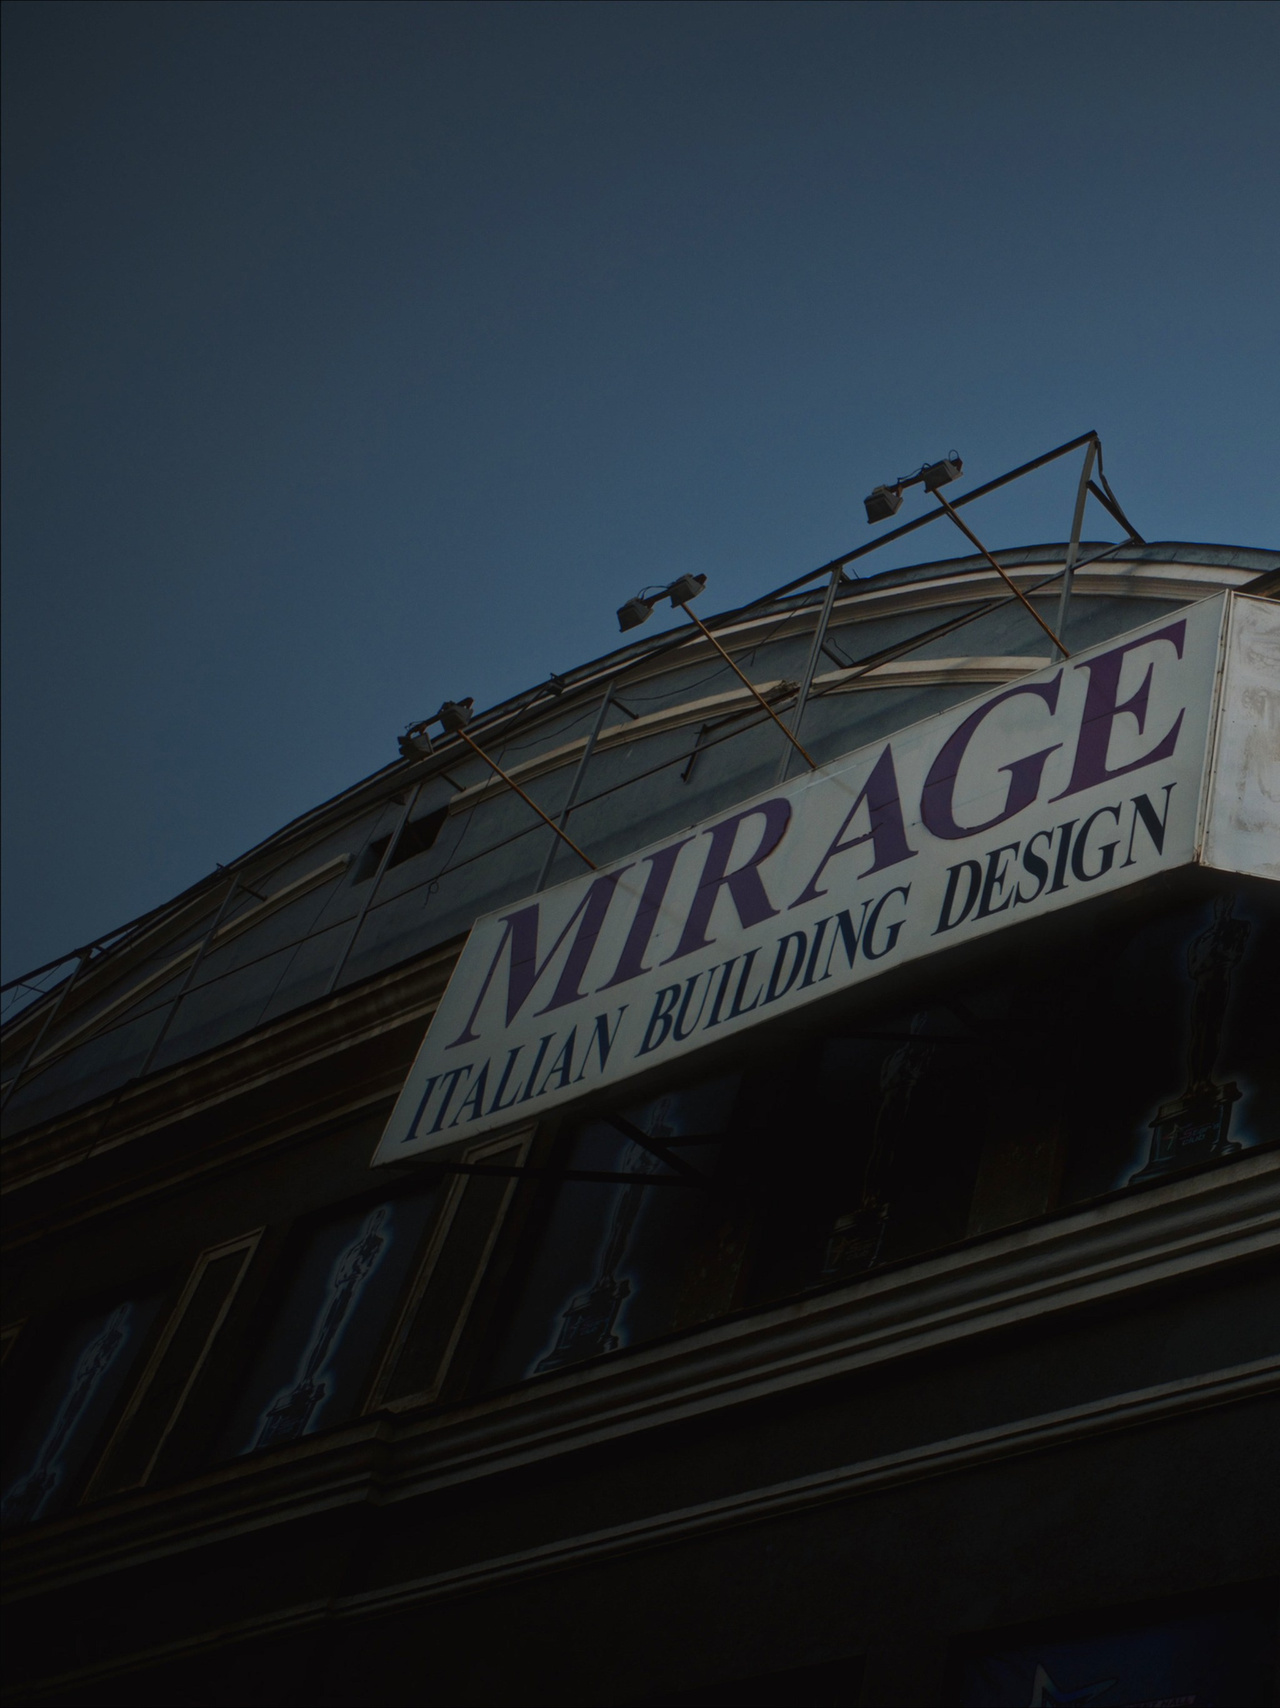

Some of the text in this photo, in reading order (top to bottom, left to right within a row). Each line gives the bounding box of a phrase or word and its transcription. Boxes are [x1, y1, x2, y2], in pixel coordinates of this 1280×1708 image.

[401, 782, 1177, 1143] ITALIAN BUILDING DESIGN
[445, 618, 1187, 1050] MIRAGE
